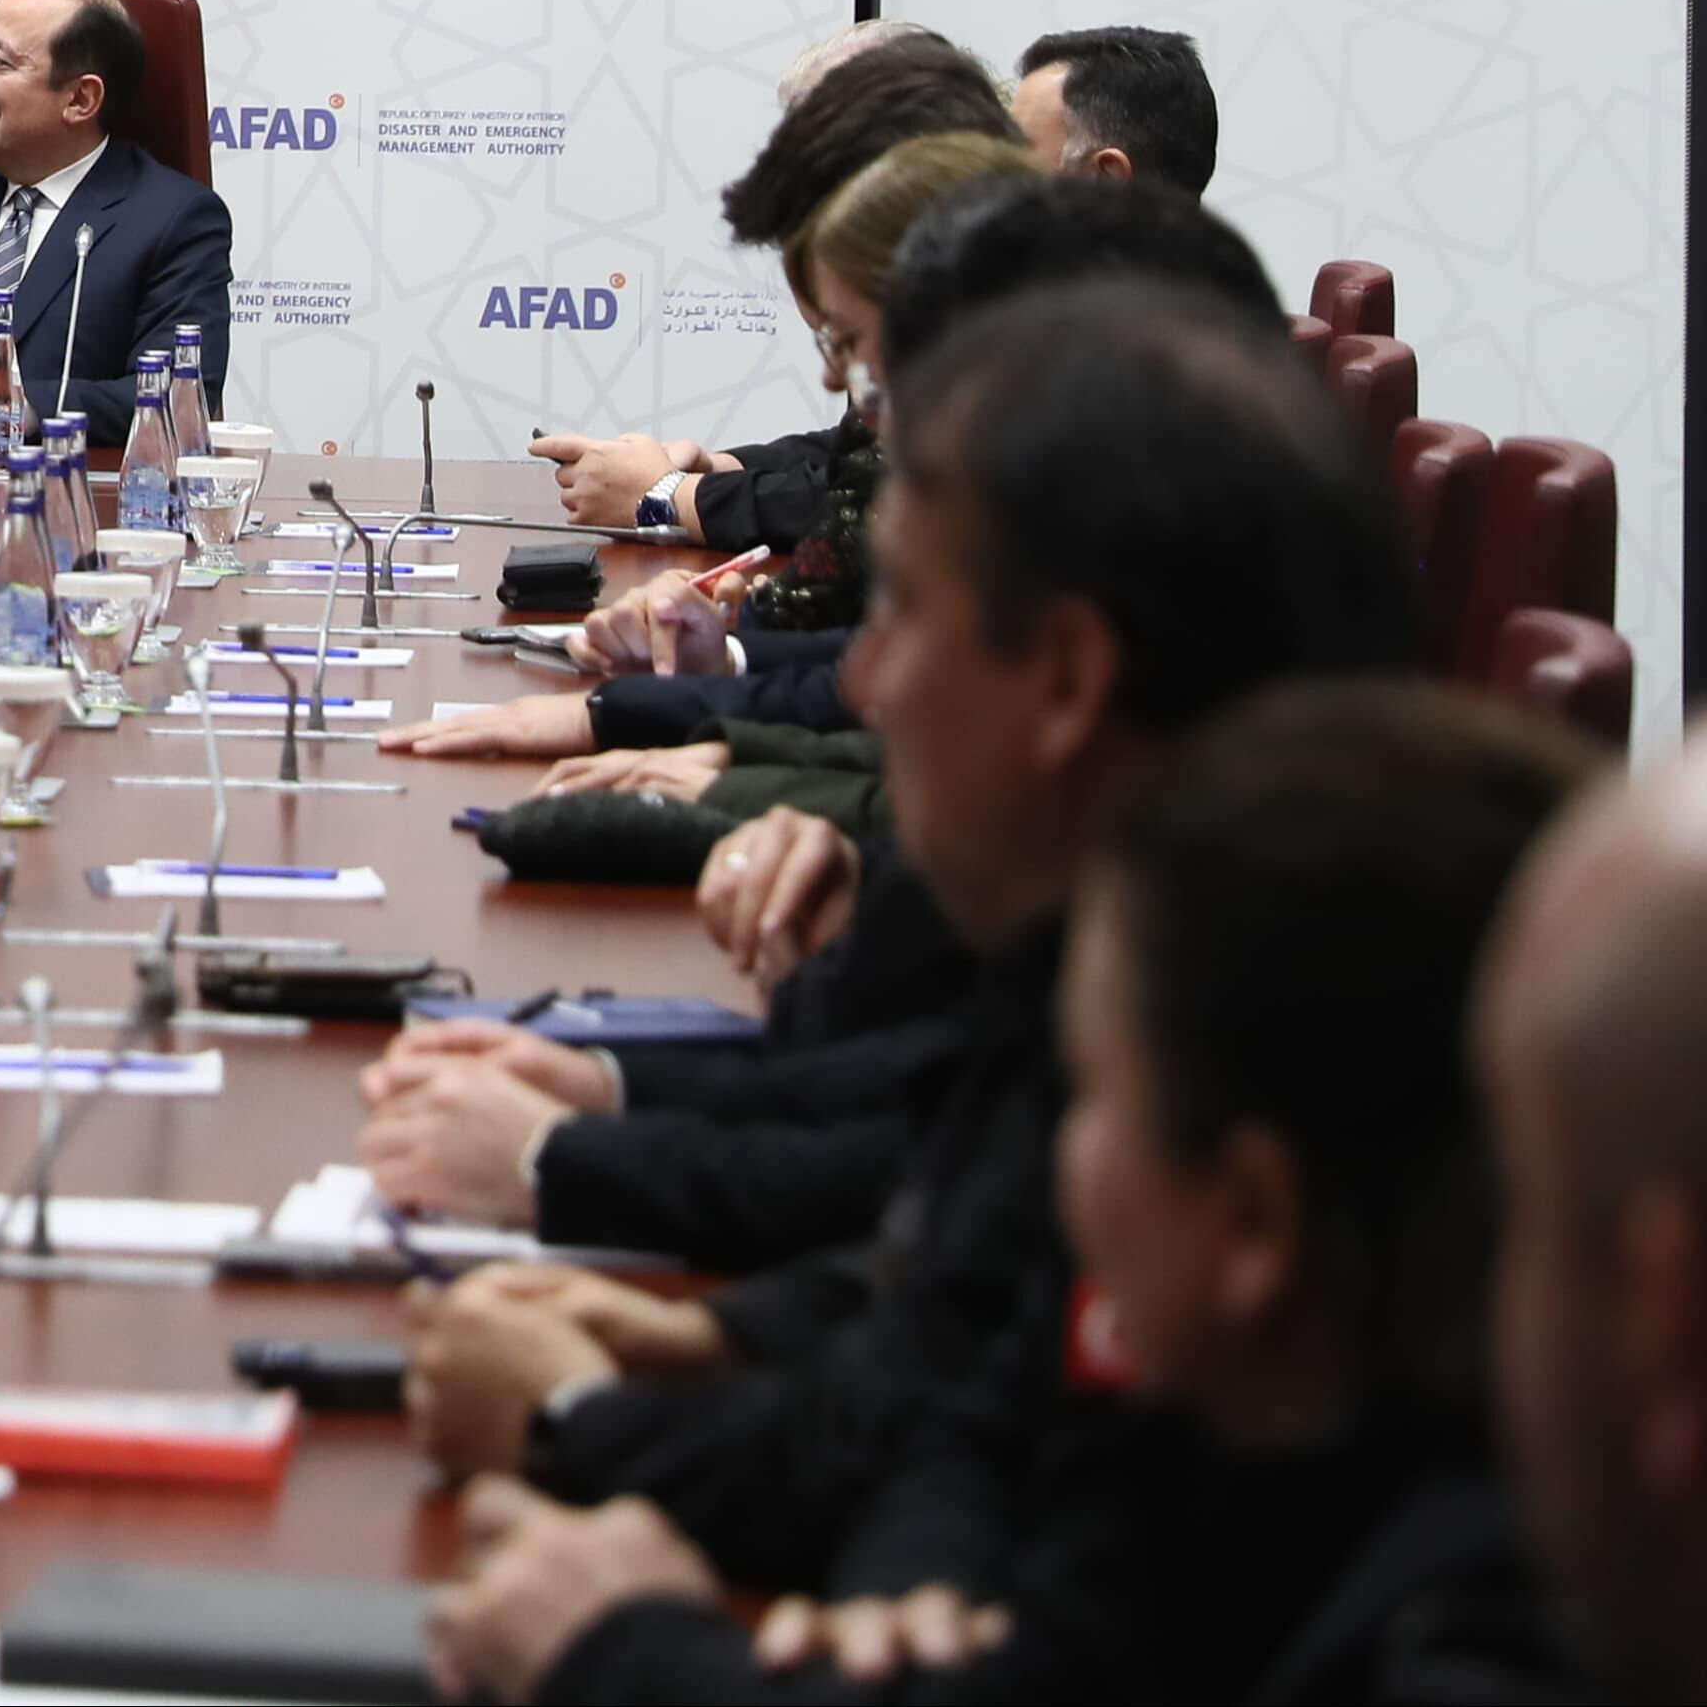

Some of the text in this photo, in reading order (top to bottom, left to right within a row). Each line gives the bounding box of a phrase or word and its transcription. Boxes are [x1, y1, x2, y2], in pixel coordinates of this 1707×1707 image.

[207, 106, 338, 150] AFAD
[378, 123, 566, 140] DISASTER AND EMERGENCY
[378, 140, 565, 156] MANAGEMENT AUTHORITY
[235, 295, 352, 308] AND EMERGENCY
[479, 286, 619, 330] AFAD
[274, 312, 351, 325] AUTHORITY
